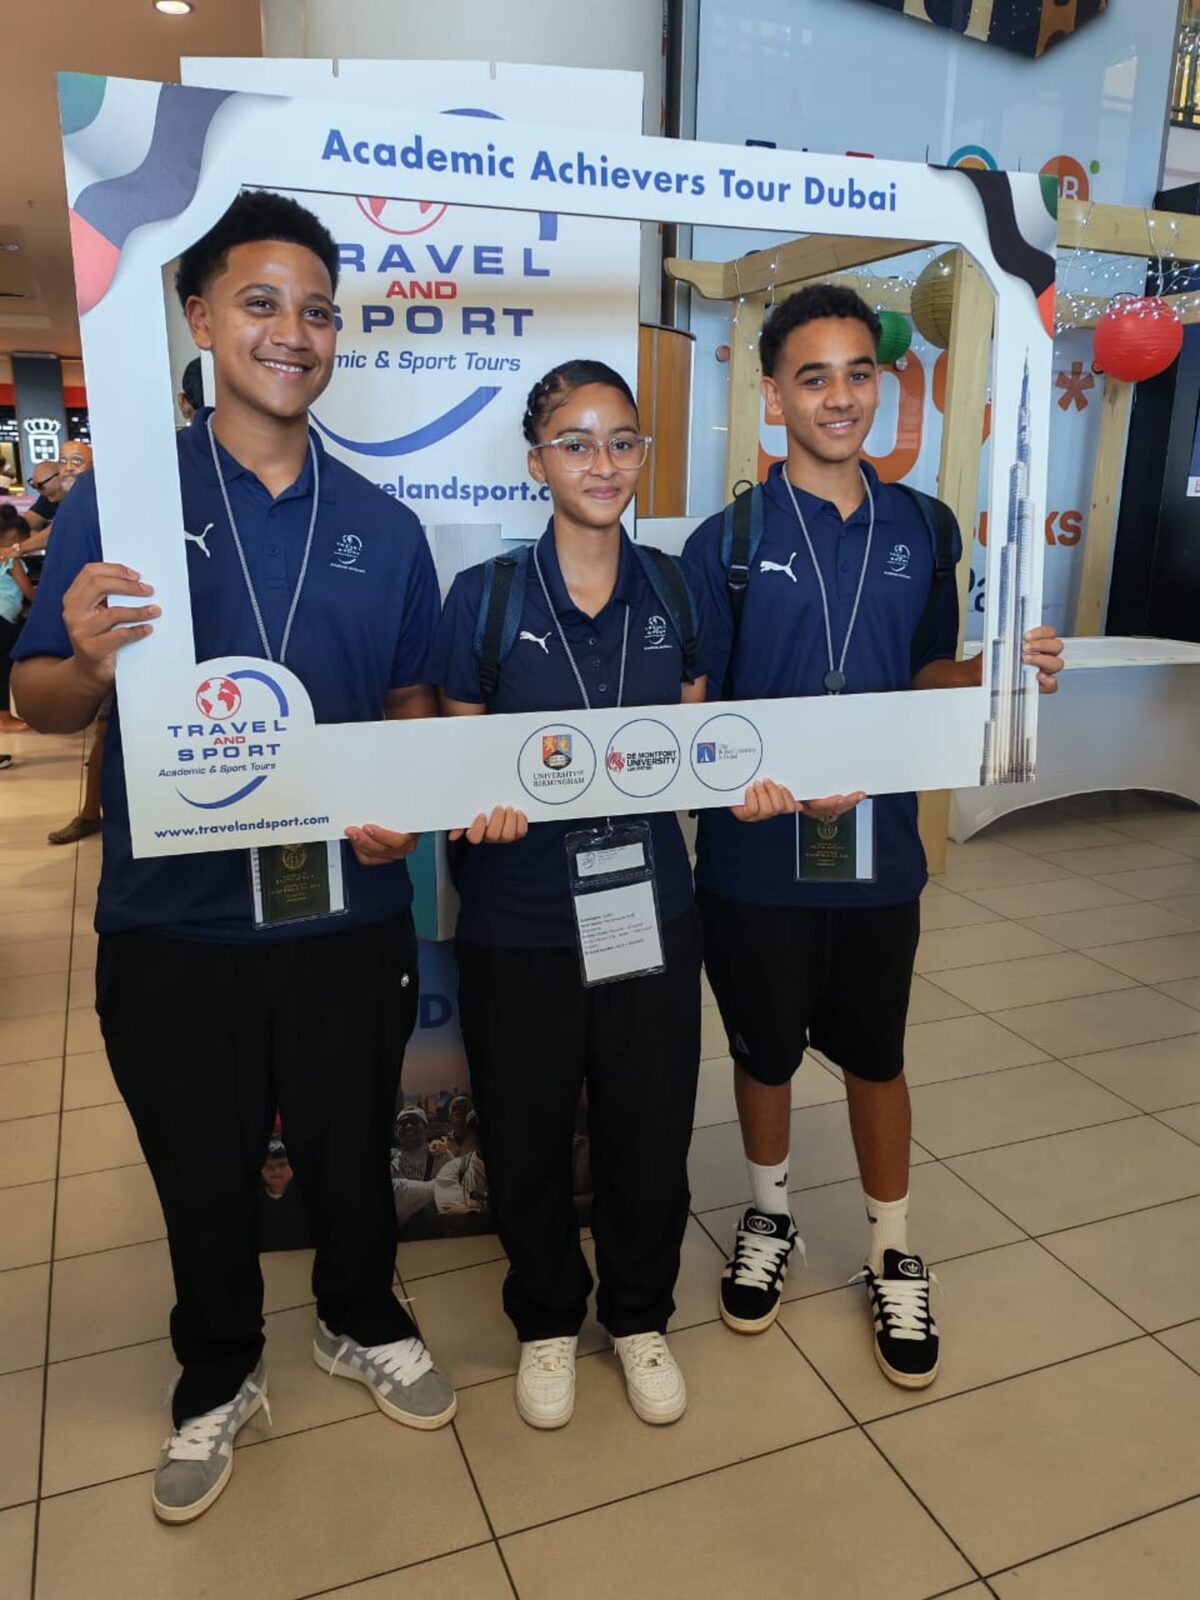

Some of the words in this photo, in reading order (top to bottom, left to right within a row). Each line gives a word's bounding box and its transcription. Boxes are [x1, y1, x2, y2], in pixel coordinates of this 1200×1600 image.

[321, 128, 516, 179] Academic
[529, 150, 706, 197] Achievers
[718, 168, 792, 203] Tour
[804, 176, 897, 212] Dubai
[335, 243, 551, 277] RAVEL
[385, 280, 458, 300] AND
[333, 350, 367, 369] mic
[374, 350, 391, 369] &
[398, 351, 457, 374] Sport
[465, 352, 521, 371] Tours
[378, 475, 551, 507] elandsport.c
[167, 719, 288, 738] TRAVEL
[212, 735, 247, 746] AND
[177, 743, 281, 762] SPORT
[627, 752, 637, 760] DE
[638, 750, 676, 759] MONTFORT
[627, 757, 676, 767] UNIVERSITY
[158, 765, 207, 778] Academic
[208, 765, 217, 774] &
[219, 763, 247, 775] Sport
[251, 762, 276, 771] Tours
[154, 815, 330, 839] www.travelandsport.com
